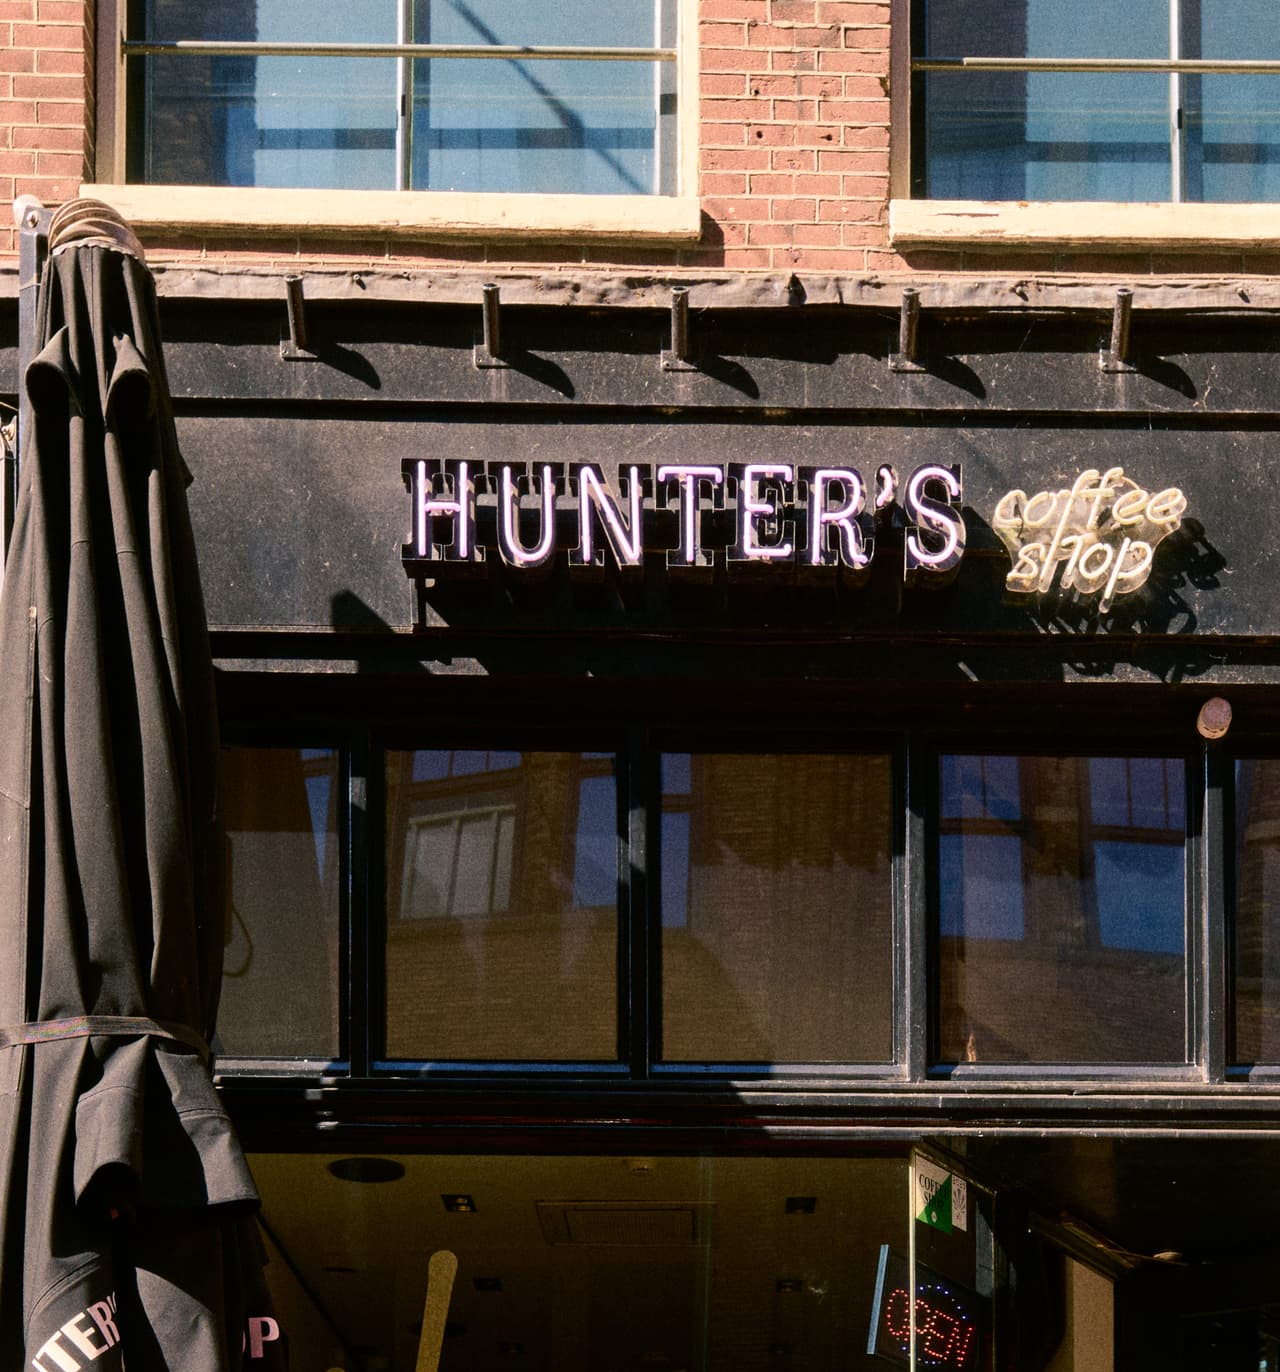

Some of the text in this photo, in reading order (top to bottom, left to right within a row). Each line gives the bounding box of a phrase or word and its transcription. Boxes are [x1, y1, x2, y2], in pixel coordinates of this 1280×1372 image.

[401, 458, 966, 578] HUNTER'S
[994, 467, 1187, 533] coffee
[1007, 530, 1156, 613] shop
[886, 1288, 975, 1368] OPEN
